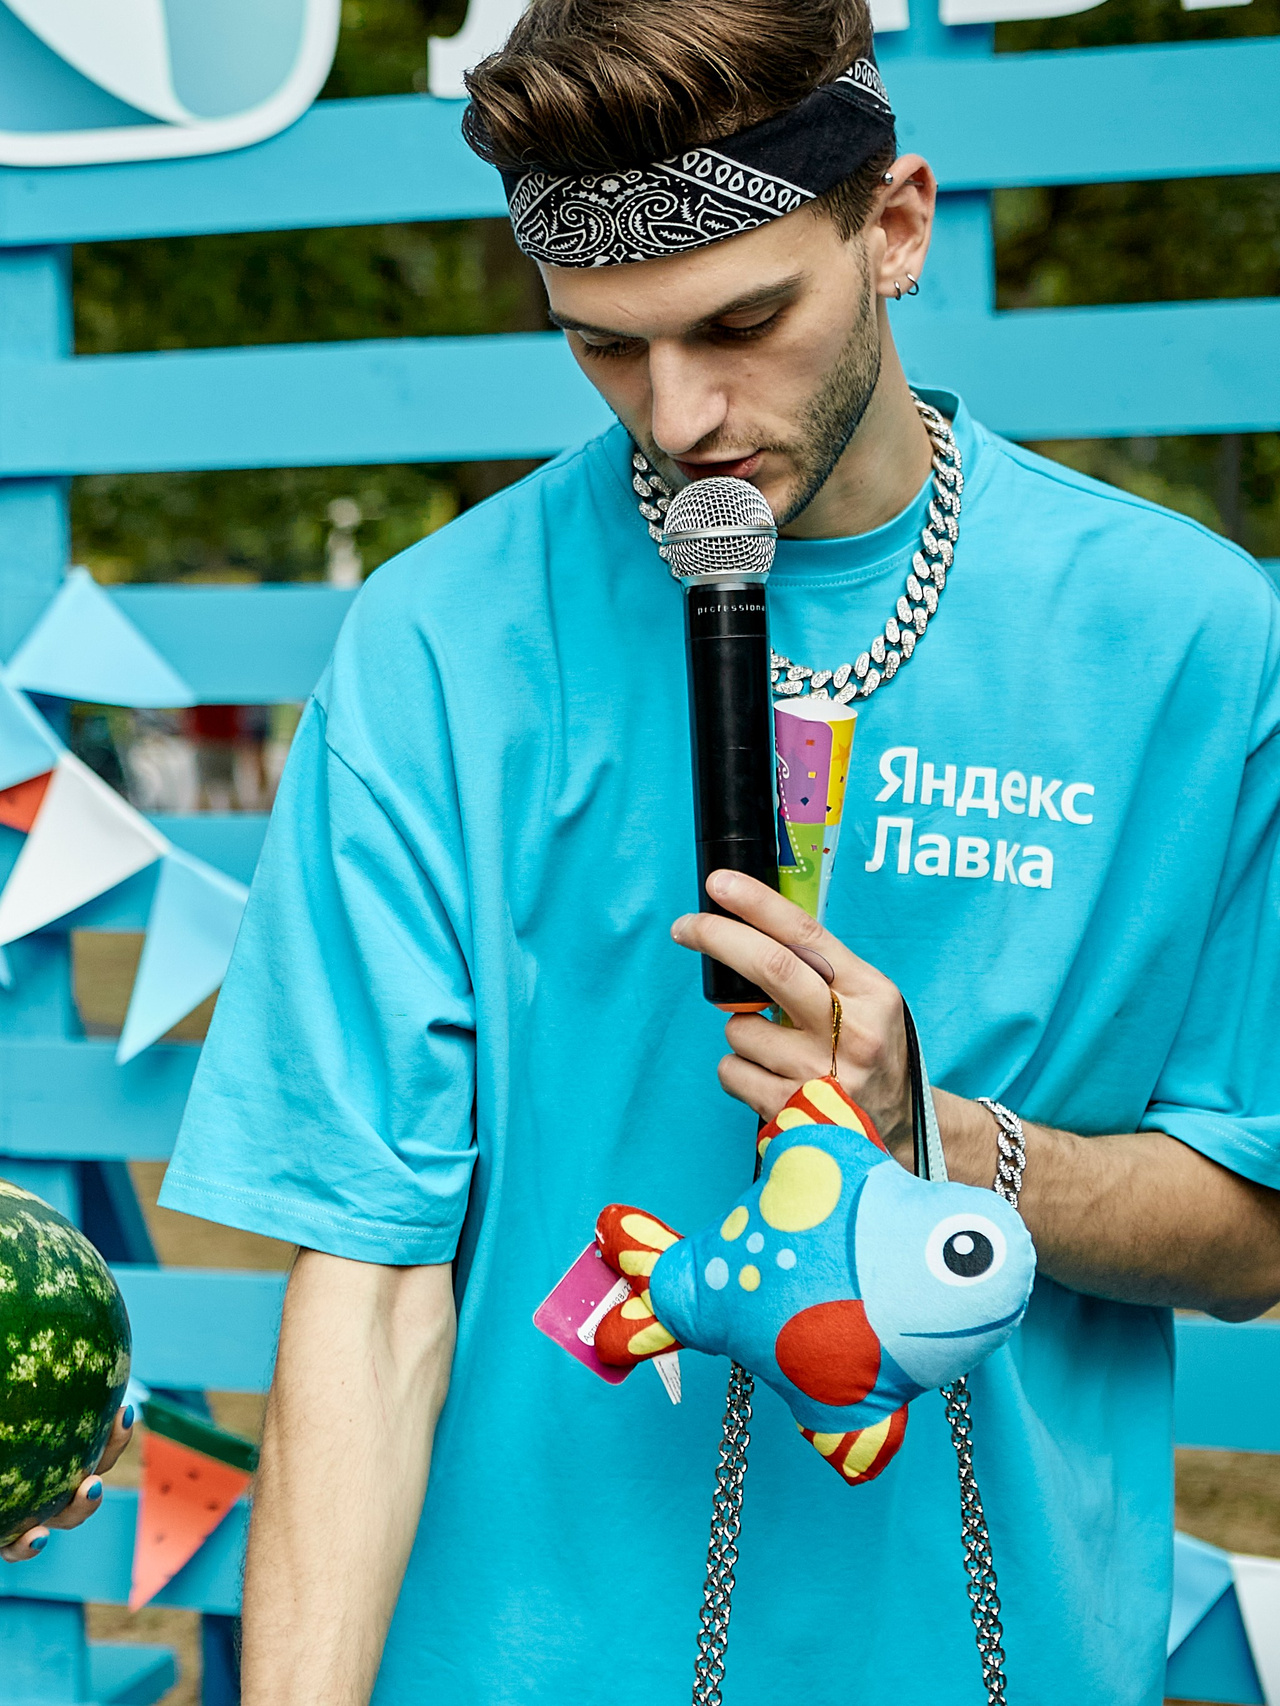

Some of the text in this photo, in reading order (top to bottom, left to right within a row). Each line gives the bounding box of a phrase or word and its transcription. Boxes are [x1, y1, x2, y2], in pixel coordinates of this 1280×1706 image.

[697, 603, 765, 616] professiona
[874, 746, 1095, 825] Яндекс
[864, 816, 1054, 890] Лавка
